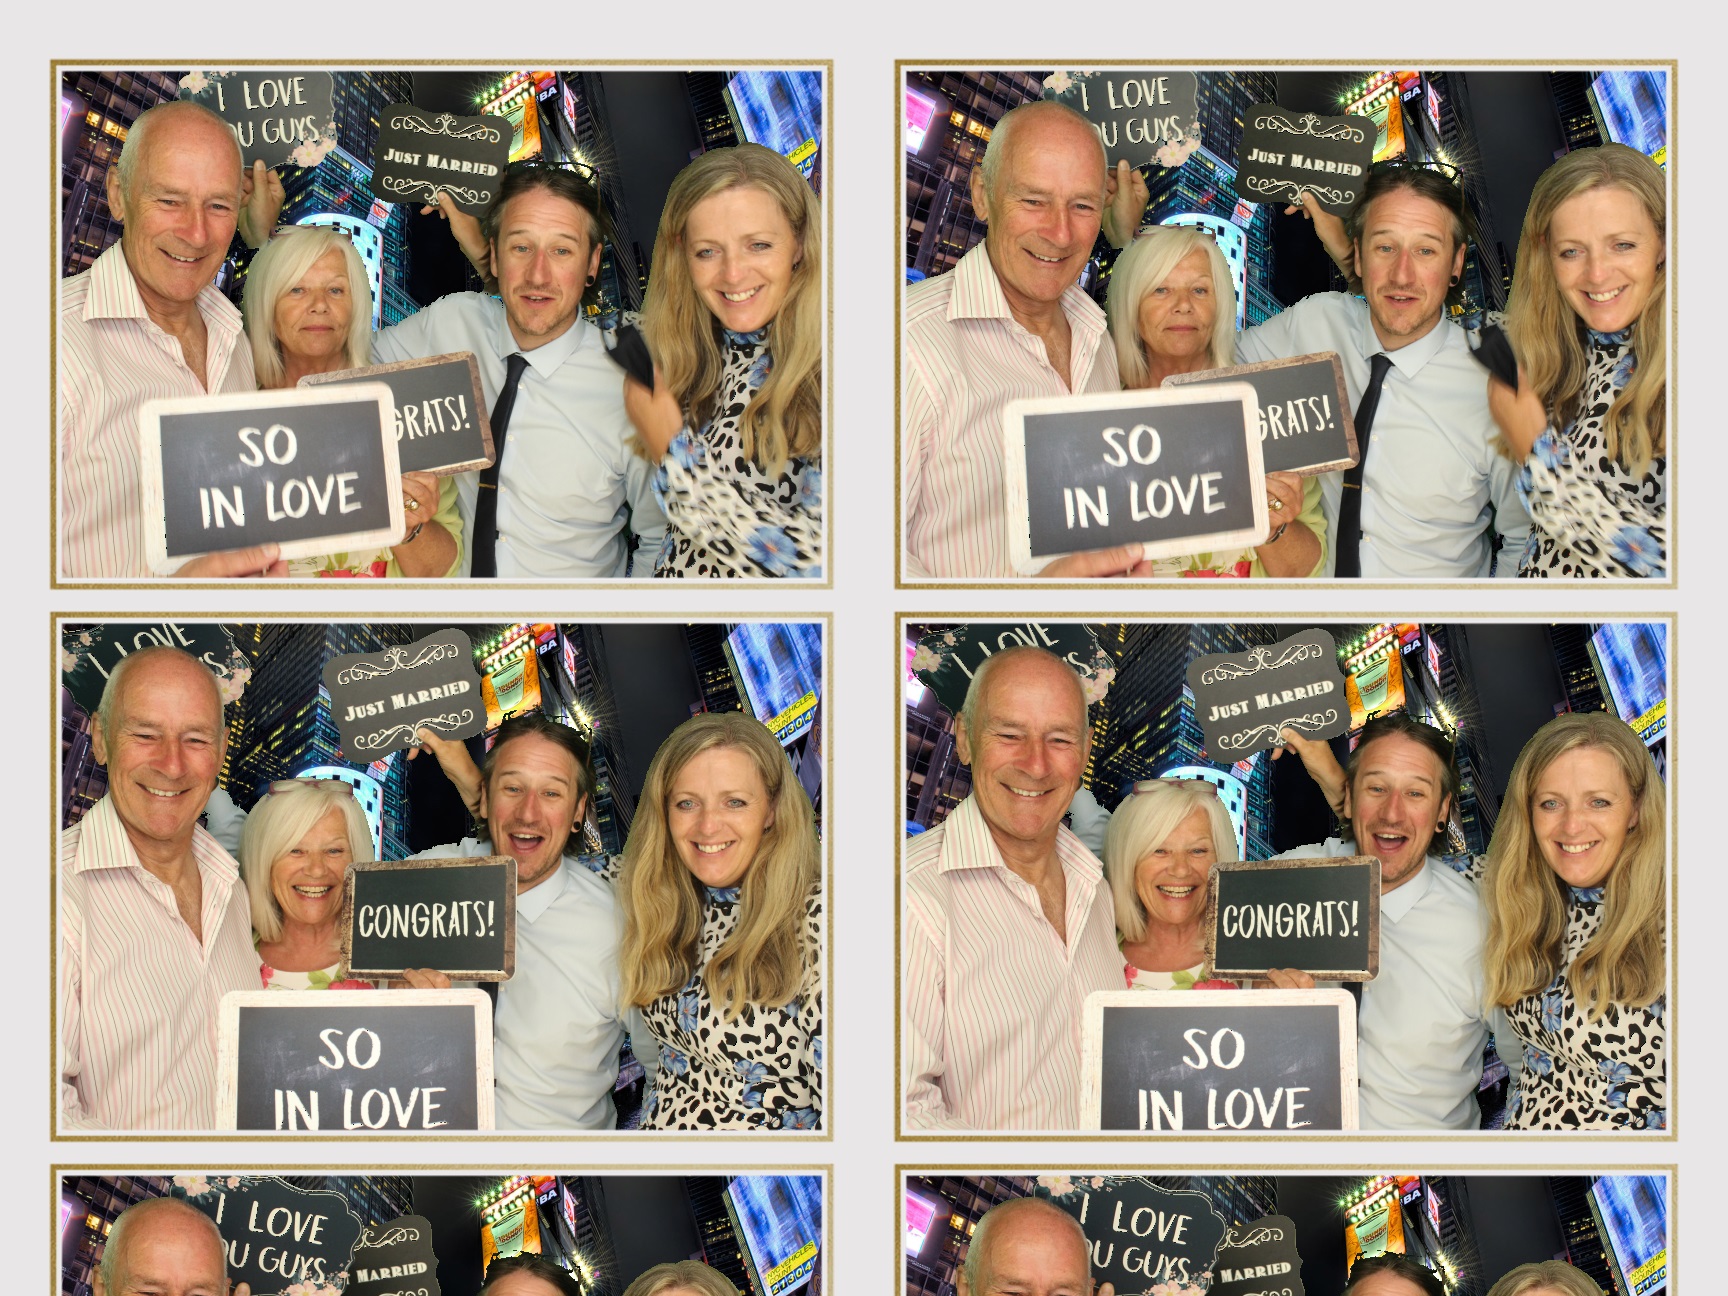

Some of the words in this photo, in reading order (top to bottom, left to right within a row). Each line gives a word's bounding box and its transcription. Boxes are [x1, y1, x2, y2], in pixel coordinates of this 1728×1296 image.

[217, 82, 225, 111] I
[243, 76, 307, 110] LOVE
[1081, 82, 1089, 111] I
[1107, 76, 1171, 110] LOVE
[262, 115, 319, 145] GUYS
[1126, 115, 1183, 145] GUYS
[383, 148, 421, 166] JUST
[426, 153, 498, 177] MARRIED
[1247, 148, 1285, 166] JUST
[1290, 153, 1362, 177] MARRIED
[239, 424, 298, 468] SO
[1103, 424, 1162, 468] SO
[200, 484, 246, 530] IN
[265, 472, 362, 522] LOVE
[1064, 484, 1110, 530] IN
[1129, 472, 1226, 522] LOVE
[345, 700, 385, 722] JUST
[390, 680, 470, 710] MARRIED
[767, 718, 781, 728] NYC
[781, 692, 814, 718] VEHICLES
[1209, 700, 1249, 722] JUST
[1254, 680, 1334, 710] MARRIED
[775, 706, 817, 738] 1304
[1631, 718, 1645, 728] NYC
[359, 901, 495, 939] CONGRATS!
[1223, 901, 1359, 939] CONGRATS!
[318, 1027, 381, 1070] SO
[1182, 1027, 1245, 1070] SO
[275, 1089, 319, 1130] IN
[344, 1087, 447, 1130] LOVE
[1139, 1089, 1183, 1130] IN
[1208, 1087, 1311, 1130] LOVE
[216, 1192, 226, 1225] I
[248, 1200, 328, 1245] LOVE
[1080, 1192, 1090, 1225] I
[1112, 1200, 1192, 1245] LOVE
[258, 1246, 327, 1284] GUYS
[356, 1261, 428, 1284] MARRIED
[767, 1268, 781, 1278] NYC
[781, 1242, 814, 1268] VEHICLES
[769, 1265, 792, 1284] COUNT
[772, 1256, 817, 1294] 21304
[1122, 1246, 1191, 1284] GUYS
[1220, 1261, 1292, 1284] MARRIED
[1631, 1268, 1645, 1278] NYC
[1633, 1265, 1656, 1284] COUNT
